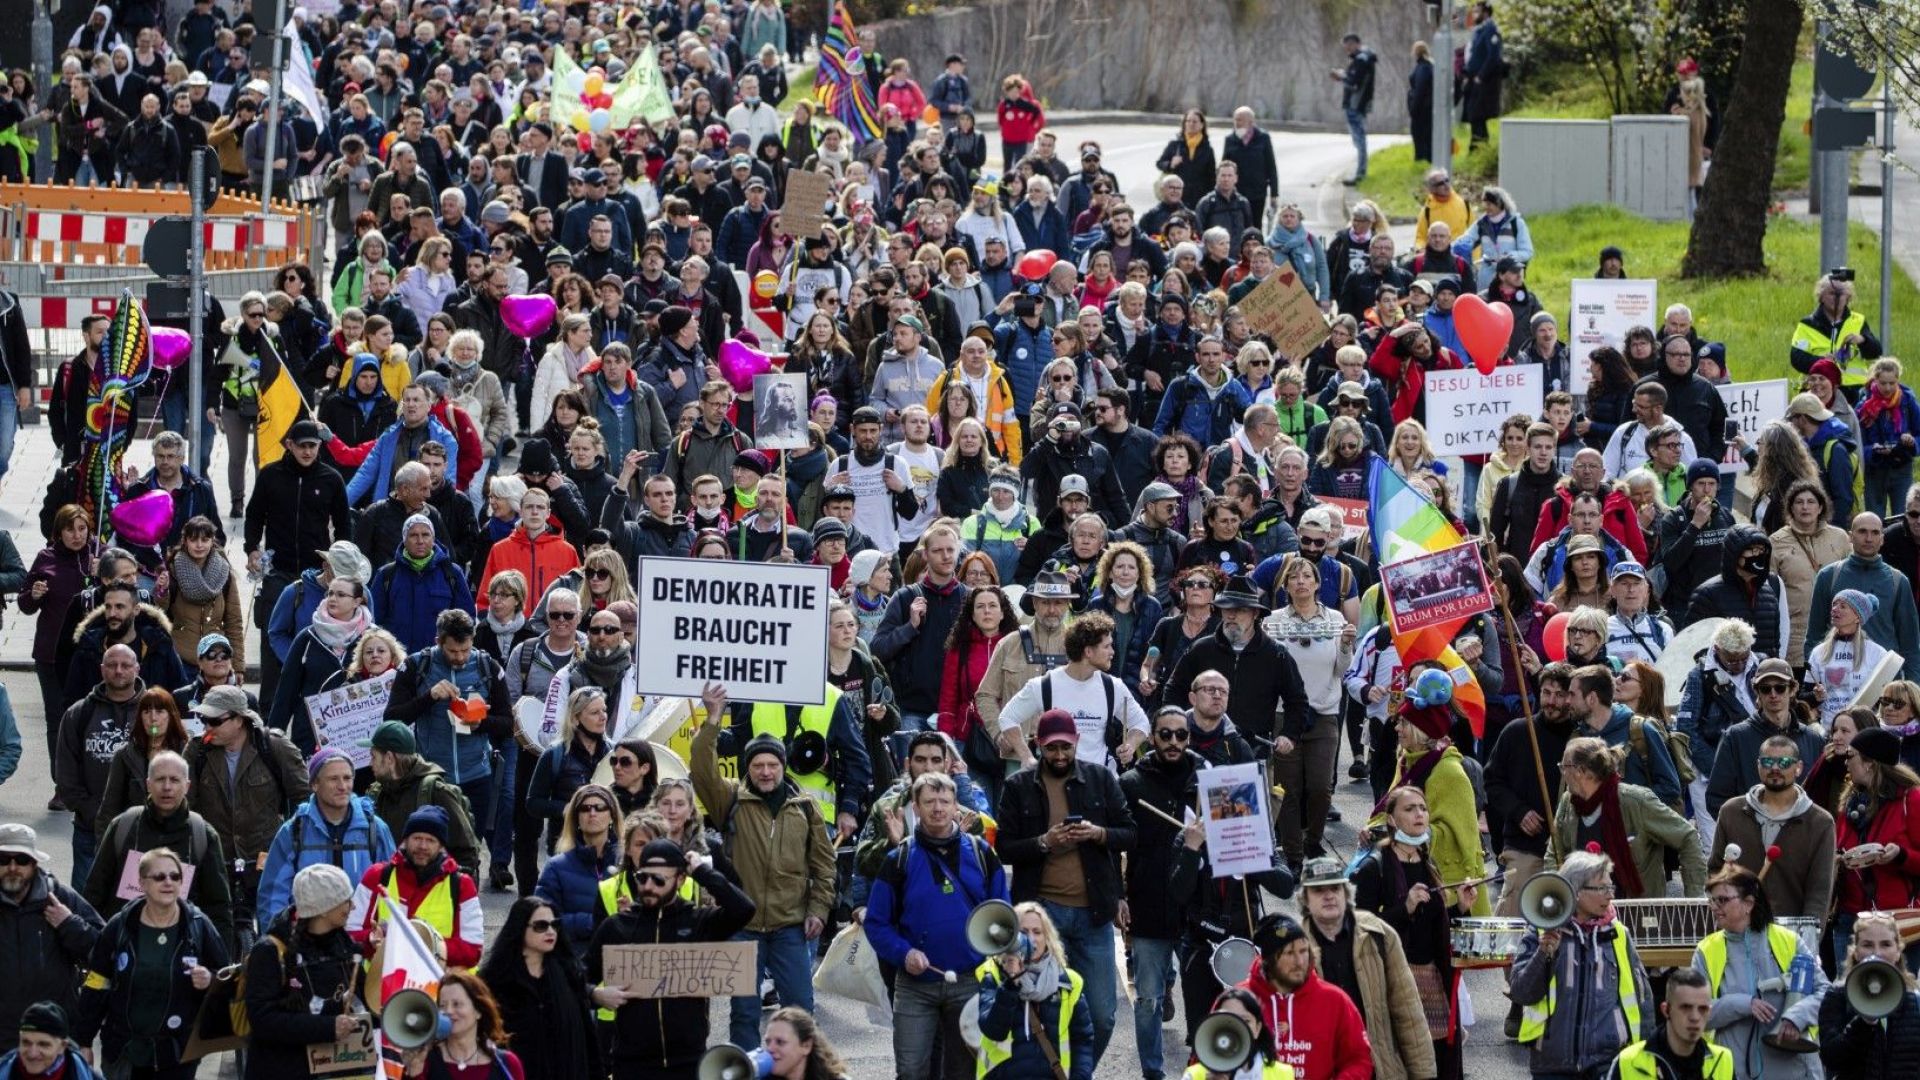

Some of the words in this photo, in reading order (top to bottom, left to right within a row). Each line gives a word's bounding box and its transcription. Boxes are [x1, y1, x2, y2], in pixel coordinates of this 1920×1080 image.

[1429, 377, 1471, 393] JESU
[1480, 373, 1525, 389] LIEBE
[1453, 401, 1511, 418] STATT
[1444, 429, 1499, 447] DIKTA
[653, 576, 816, 611] DEMOKRATIE
[1397, 611, 1432, 627] DRUM
[1433, 603, 1457, 617] FOR
[1458, 594, 1488, 610] LOVE
[674, 616, 792, 647] BRAUCHT
[676, 654, 788, 685] FREIHEIT
